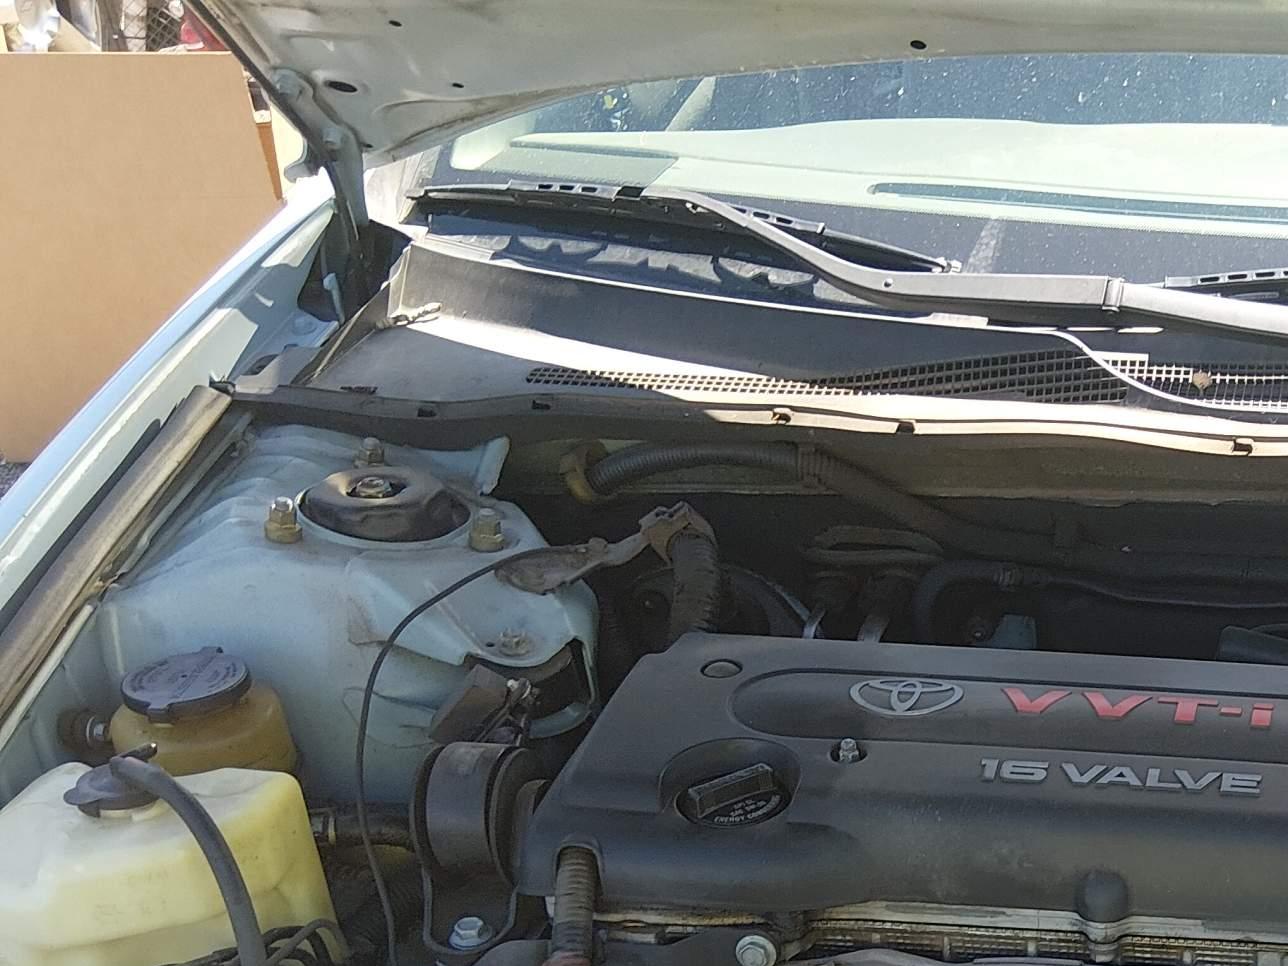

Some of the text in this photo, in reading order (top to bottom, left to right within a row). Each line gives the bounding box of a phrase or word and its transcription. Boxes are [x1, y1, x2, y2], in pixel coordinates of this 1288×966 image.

[1001, 687, 1275, 727] VVT-i
[981, 758, 1263, 795] 16 VALVE
